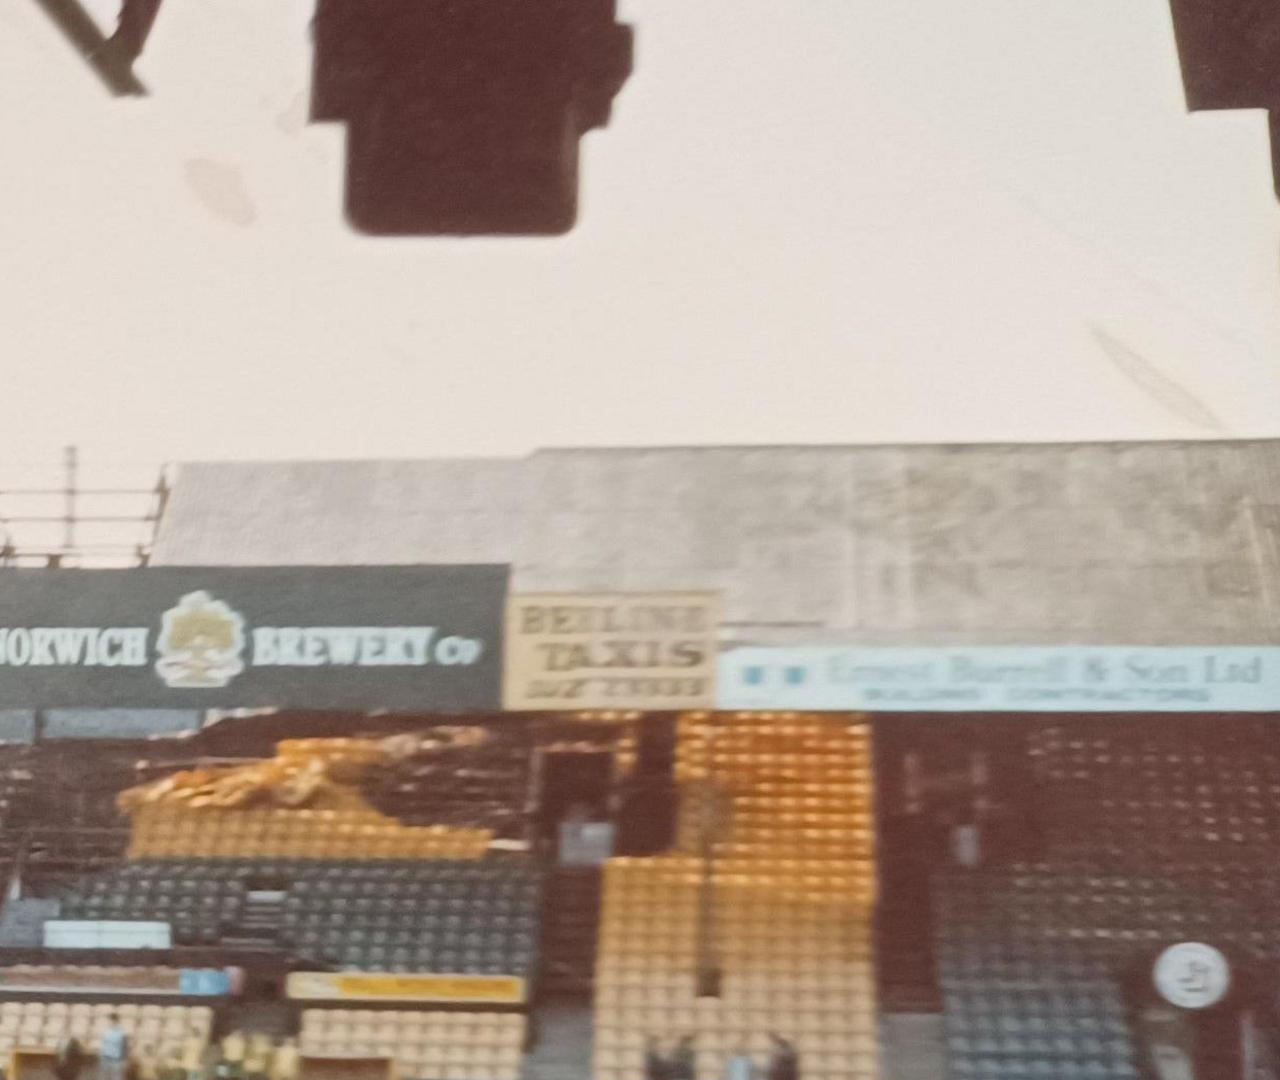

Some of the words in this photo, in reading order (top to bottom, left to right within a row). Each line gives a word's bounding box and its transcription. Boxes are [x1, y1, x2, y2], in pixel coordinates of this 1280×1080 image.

[252, 626, 438, 666] BREWERY
[536, 640, 705, 671] TAXIS
[1205, 655, 1262, 684] Ltd
